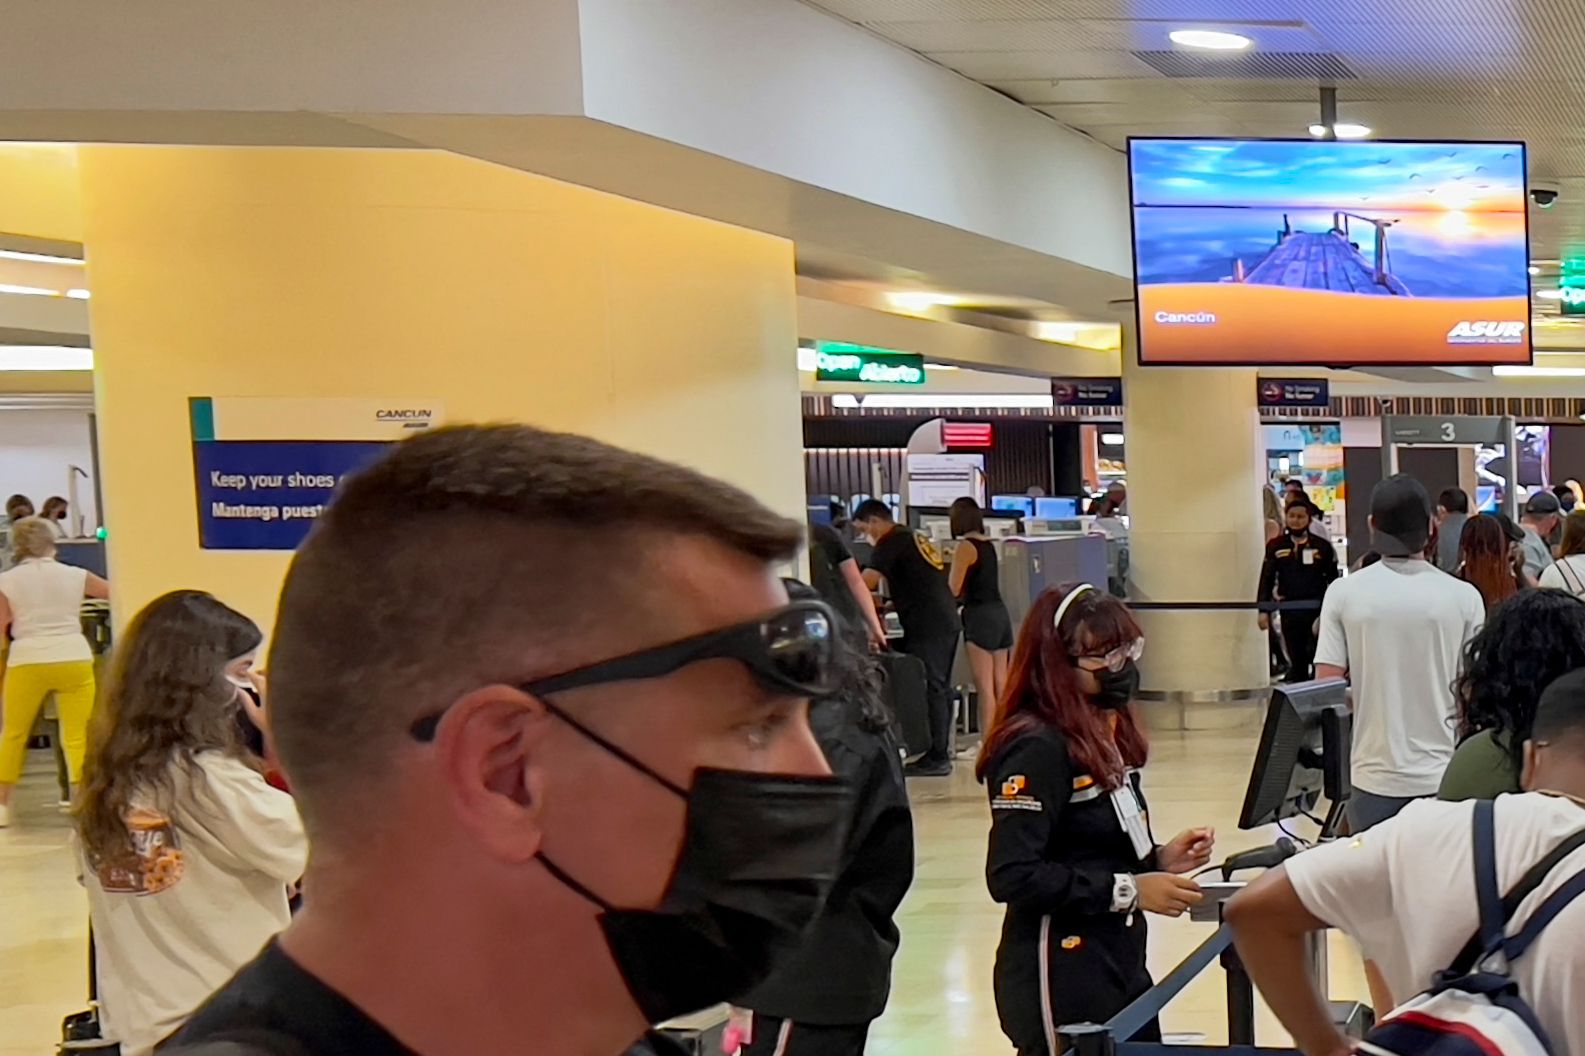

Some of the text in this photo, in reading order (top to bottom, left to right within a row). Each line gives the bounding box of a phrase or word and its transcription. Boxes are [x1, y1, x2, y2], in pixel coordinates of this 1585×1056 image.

[1154, 310, 1216, 324] Cancún
[1448, 320, 1525, 338] ASUR
[1441, 422, 1456, 442] 3
[211, 471, 246, 490] Keep
[249, 474, 283, 491] your
[288, 471, 335, 488] shoes
[212, 502, 280, 521] Mantenga
